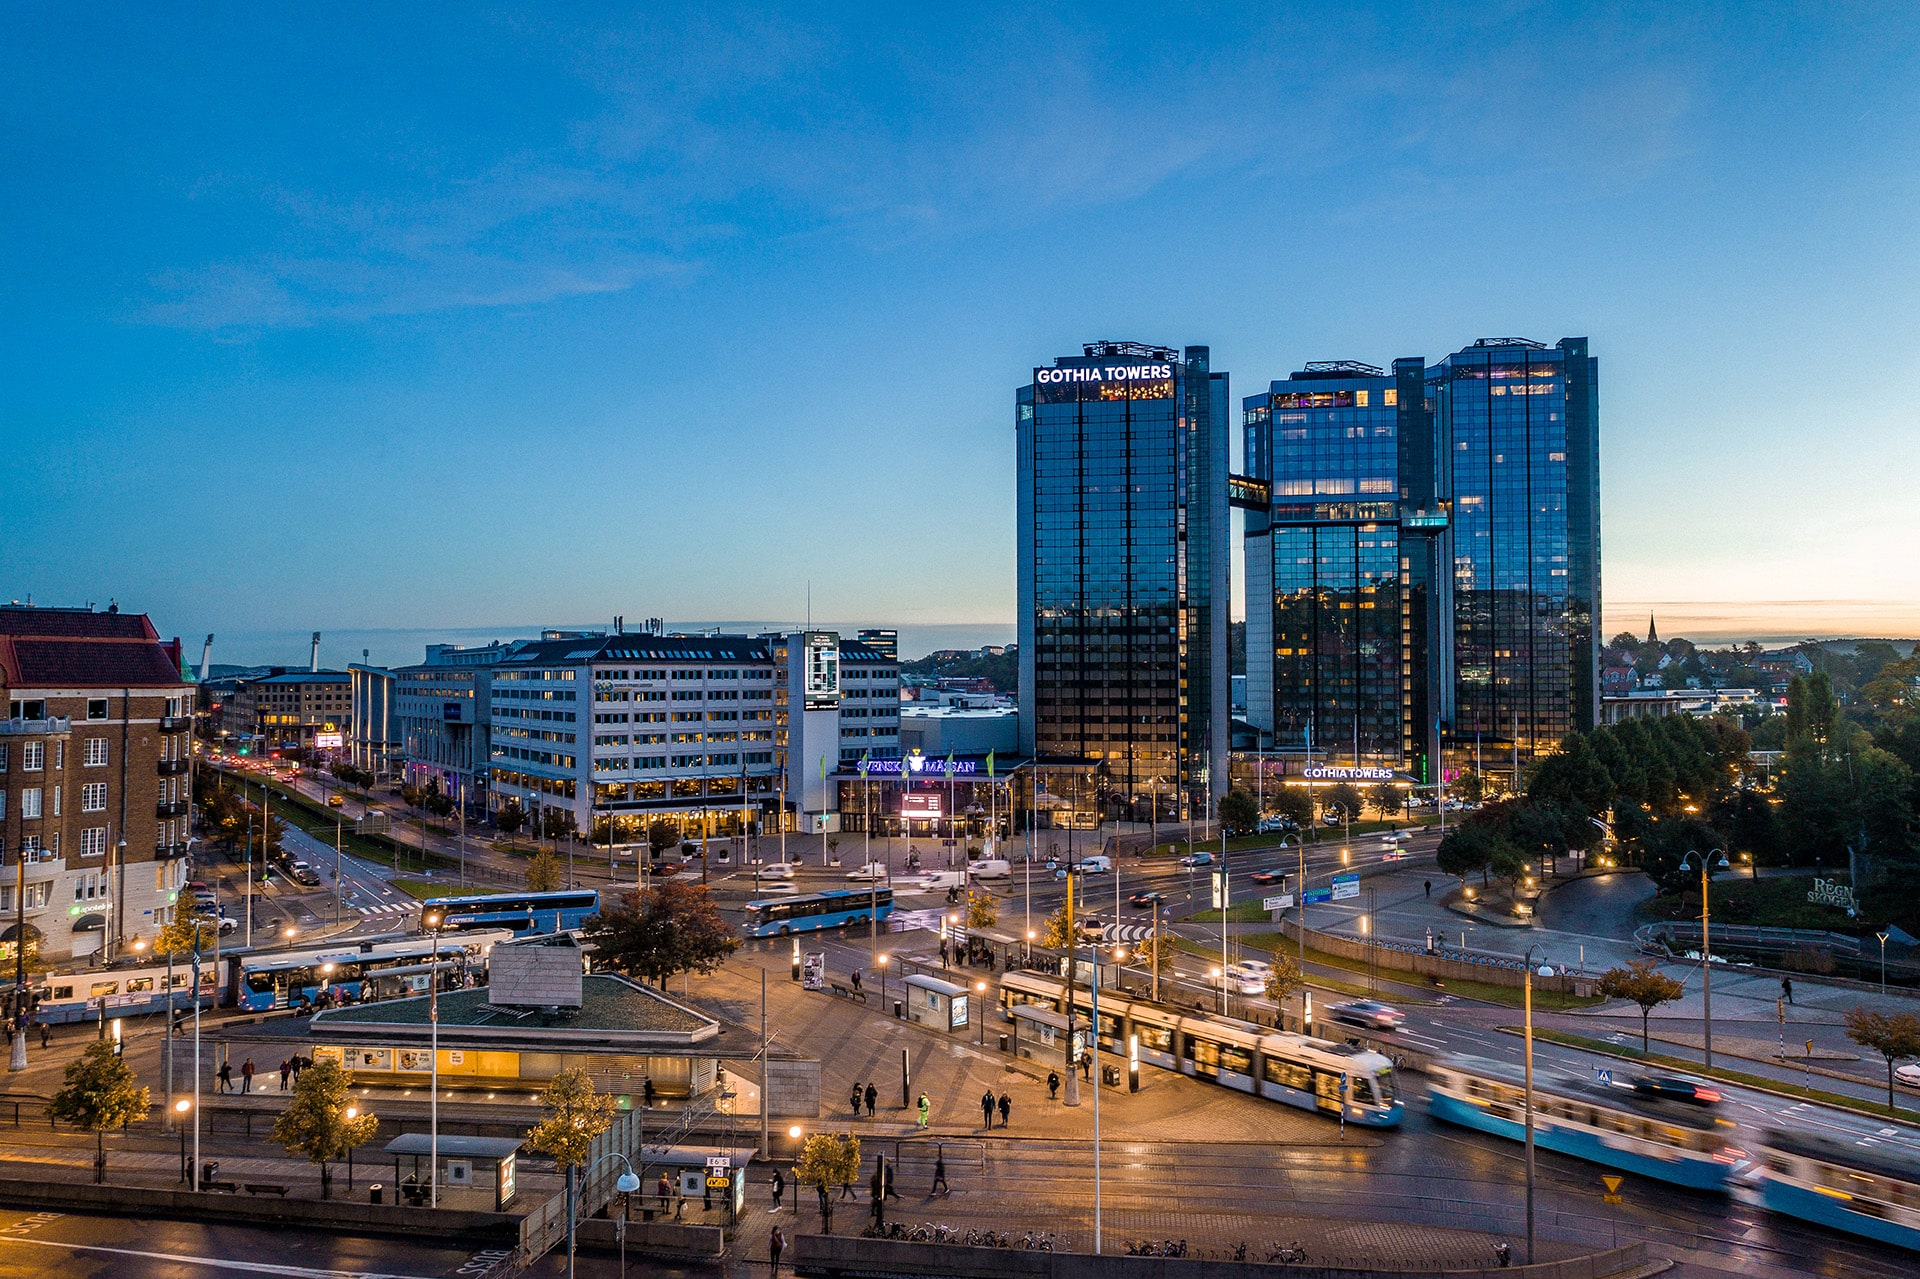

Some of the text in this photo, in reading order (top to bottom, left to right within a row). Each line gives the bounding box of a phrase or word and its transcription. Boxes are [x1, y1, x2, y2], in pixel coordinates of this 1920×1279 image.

[1037, 364, 1172, 384] GOTHIA TOWERS
[1303, 768, 1393, 779] GOTHIA TOWERS
[1813, 877, 1854, 897] REGN
[1807, 890, 1860, 909] SKOGEN
[0, 1211, 66, 1235] BUSS
[455, 1249, 513, 1275] BUSS
